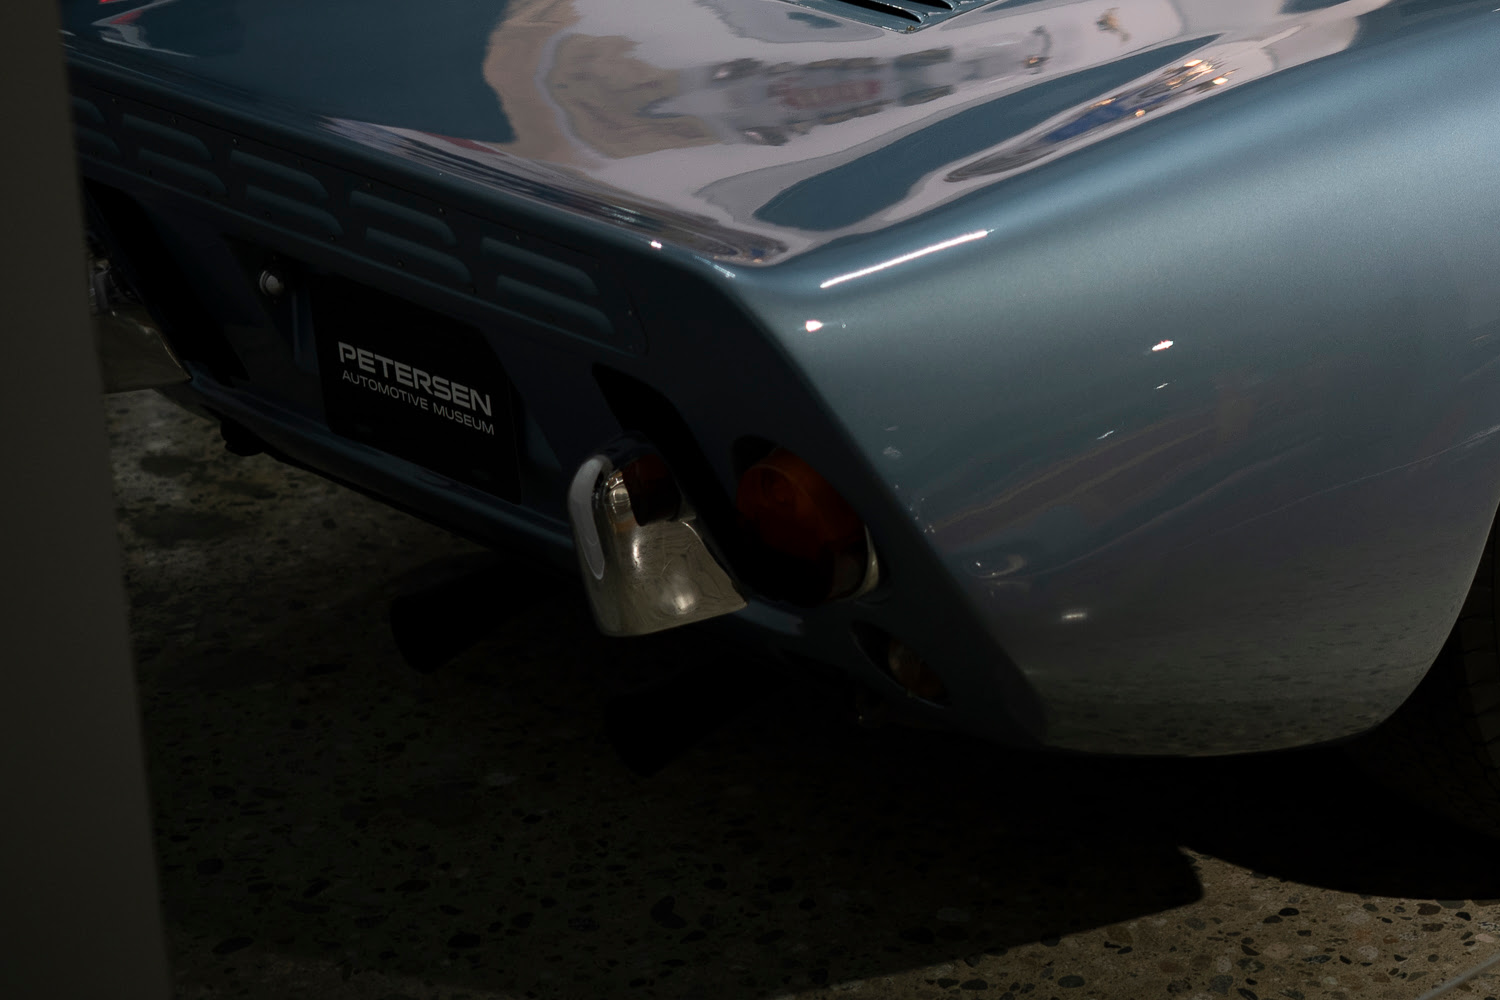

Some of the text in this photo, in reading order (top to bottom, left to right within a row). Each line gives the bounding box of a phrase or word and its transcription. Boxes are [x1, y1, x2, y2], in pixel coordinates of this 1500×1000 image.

[338, 341, 492, 417] PETERSEN
[342, 370, 495, 436] AUTOMOTIVE MUSEUM
